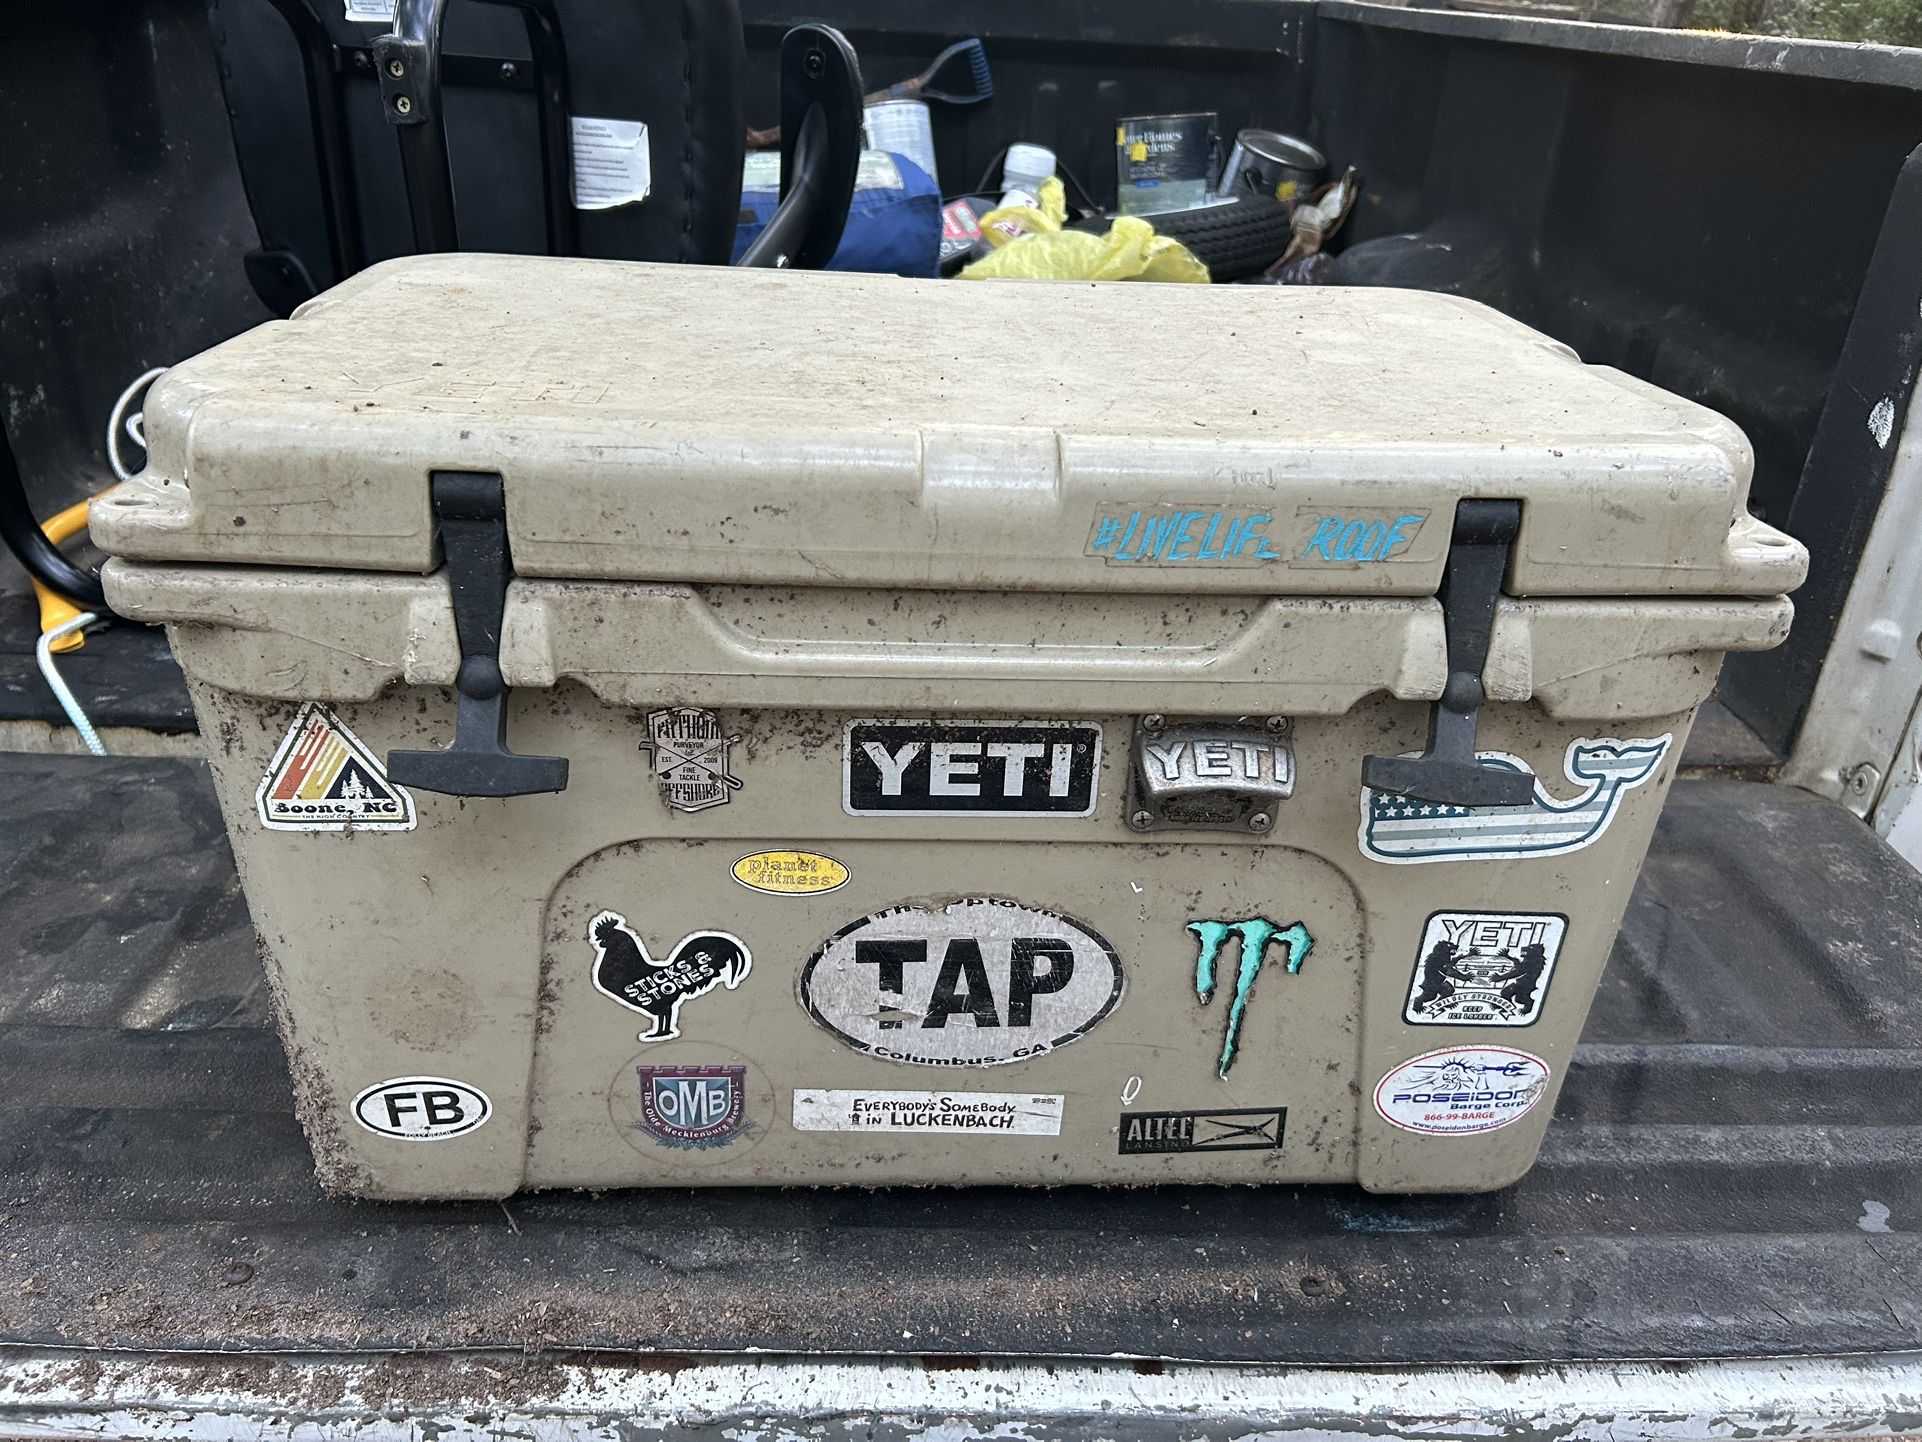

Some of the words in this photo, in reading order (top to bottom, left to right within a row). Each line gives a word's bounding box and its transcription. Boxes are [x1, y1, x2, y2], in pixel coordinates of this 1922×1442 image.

[673, 741, 704, 749] PURVEYOR
[861, 742, 1073, 797] YETI
[1146, 740, 1291, 783] YETI
[362, 802, 397, 813] NC
[748, 857, 818, 874] planet
[757, 870, 831, 886] fitness
[1442, 920, 1546, 947] YETI
[624, 959, 693, 999] STICKS
[637, 965, 715, 1006] STONES
[855, 937, 1075, 1029] TAP
[1012, 1043, 1048, 1058] GA
[644, 1091, 652, 1106] The
[658, 1081, 726, 1126] OMB
[383, 1090, 465, 1127] FB
[645, 1107, 661, 1126] Olde
[1424, 1111, 1496, 1121] 866-99-BARGE
[1412, 1117, 1507, 1131] www.poseidonbarge.com
